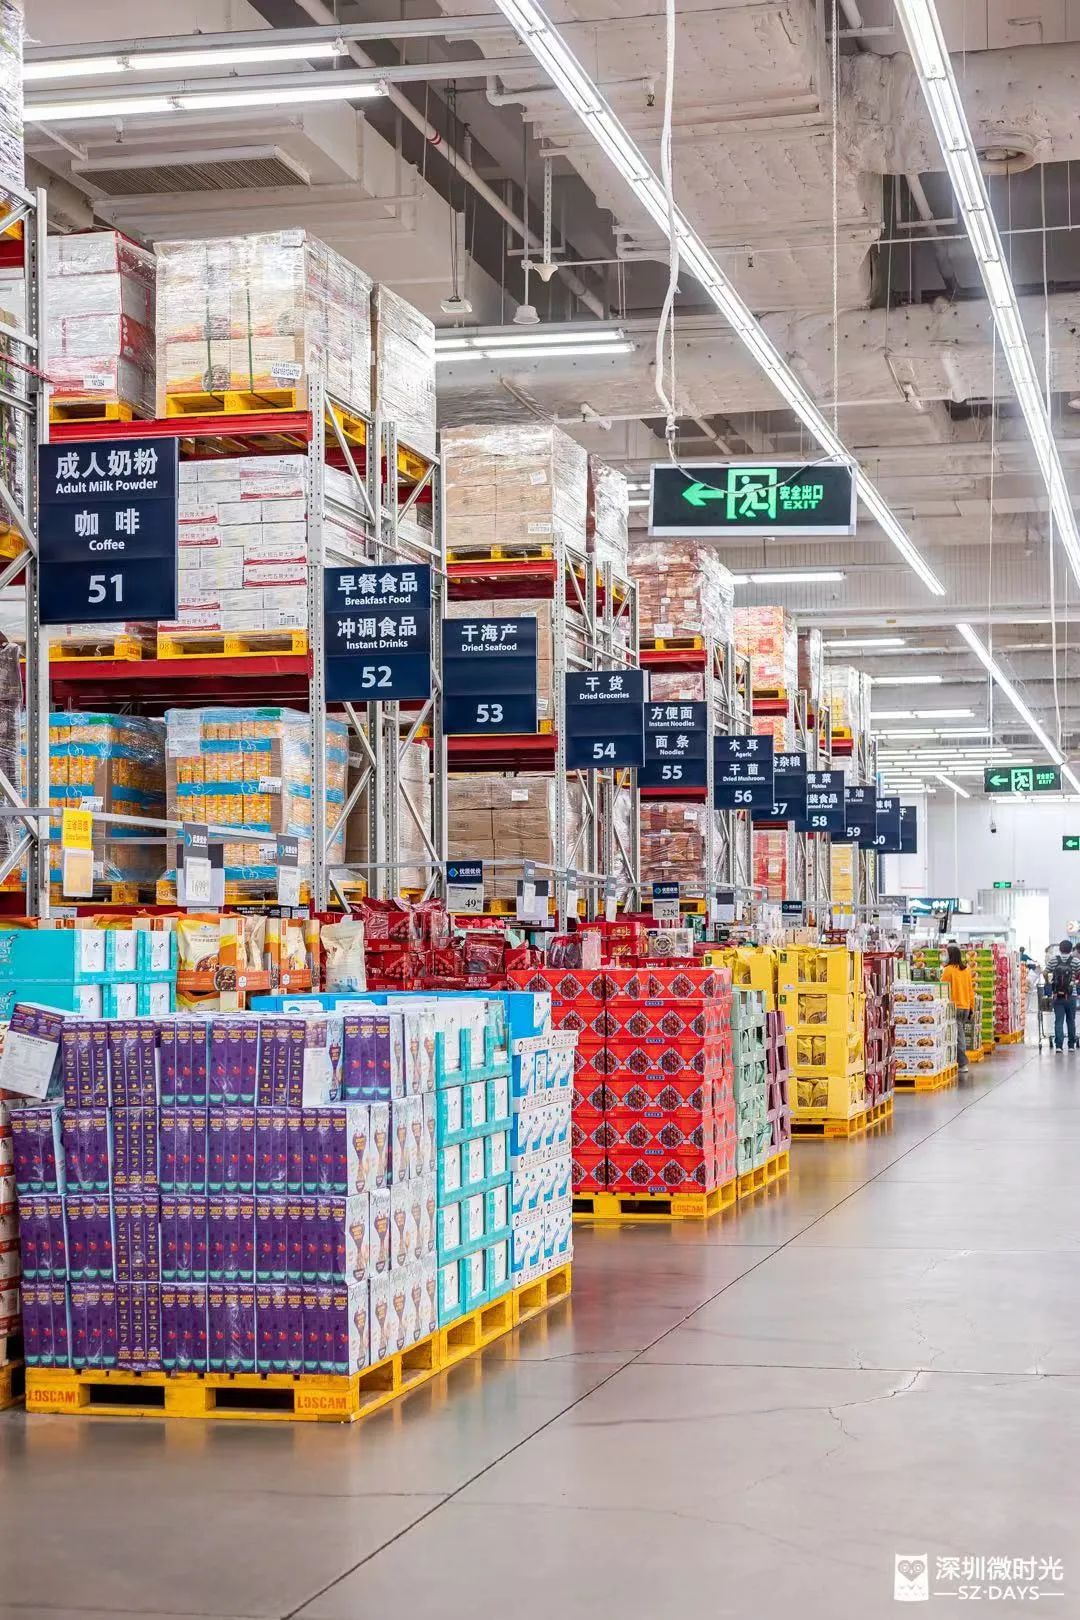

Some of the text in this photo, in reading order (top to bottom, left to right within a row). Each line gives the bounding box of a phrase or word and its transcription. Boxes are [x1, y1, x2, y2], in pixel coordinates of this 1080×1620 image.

[56, 448, 158, 479] 成人奶粉
[56, 478, 158, 494] Adult Milk Powder
[779, 485, 824, 500] 安全出口
[784, 500, 818, 510] EXIT
[74, 508, 140, 536] 咖啡
[88, 539, 125, 550] Coffee
[88, 574, 124, 604] 51
[337, 572, 418, 596] 早餐食品
[345, 594, 411, 606] Breakfast Food
[337, 616, 417, 639] 冲调食品
[461, 624, 518, 642] 干海产
[346, 639, 408, 650] Instant Drinks
[462, 643, 517, 652] Dried Seafood
[361, 666, 392, 688] 52
[585, 676, 623, 691] 干货
[476, 704, 503, 723] 53
[651, 706, 693, 720] 方便面
[656, 735, 689, 748] 面条
[730, 740, 758, 751] 木耳
[593, 743, 616, 759] 54
[661, 766, 683, 780] 55
[734, 790, 752, 803] 56
[807, 794, 837, 804] 装食品
[771, 803, 788, 815] 57
[812, 816, 827, 826] 58
[847, 827, 860, 837] 59
